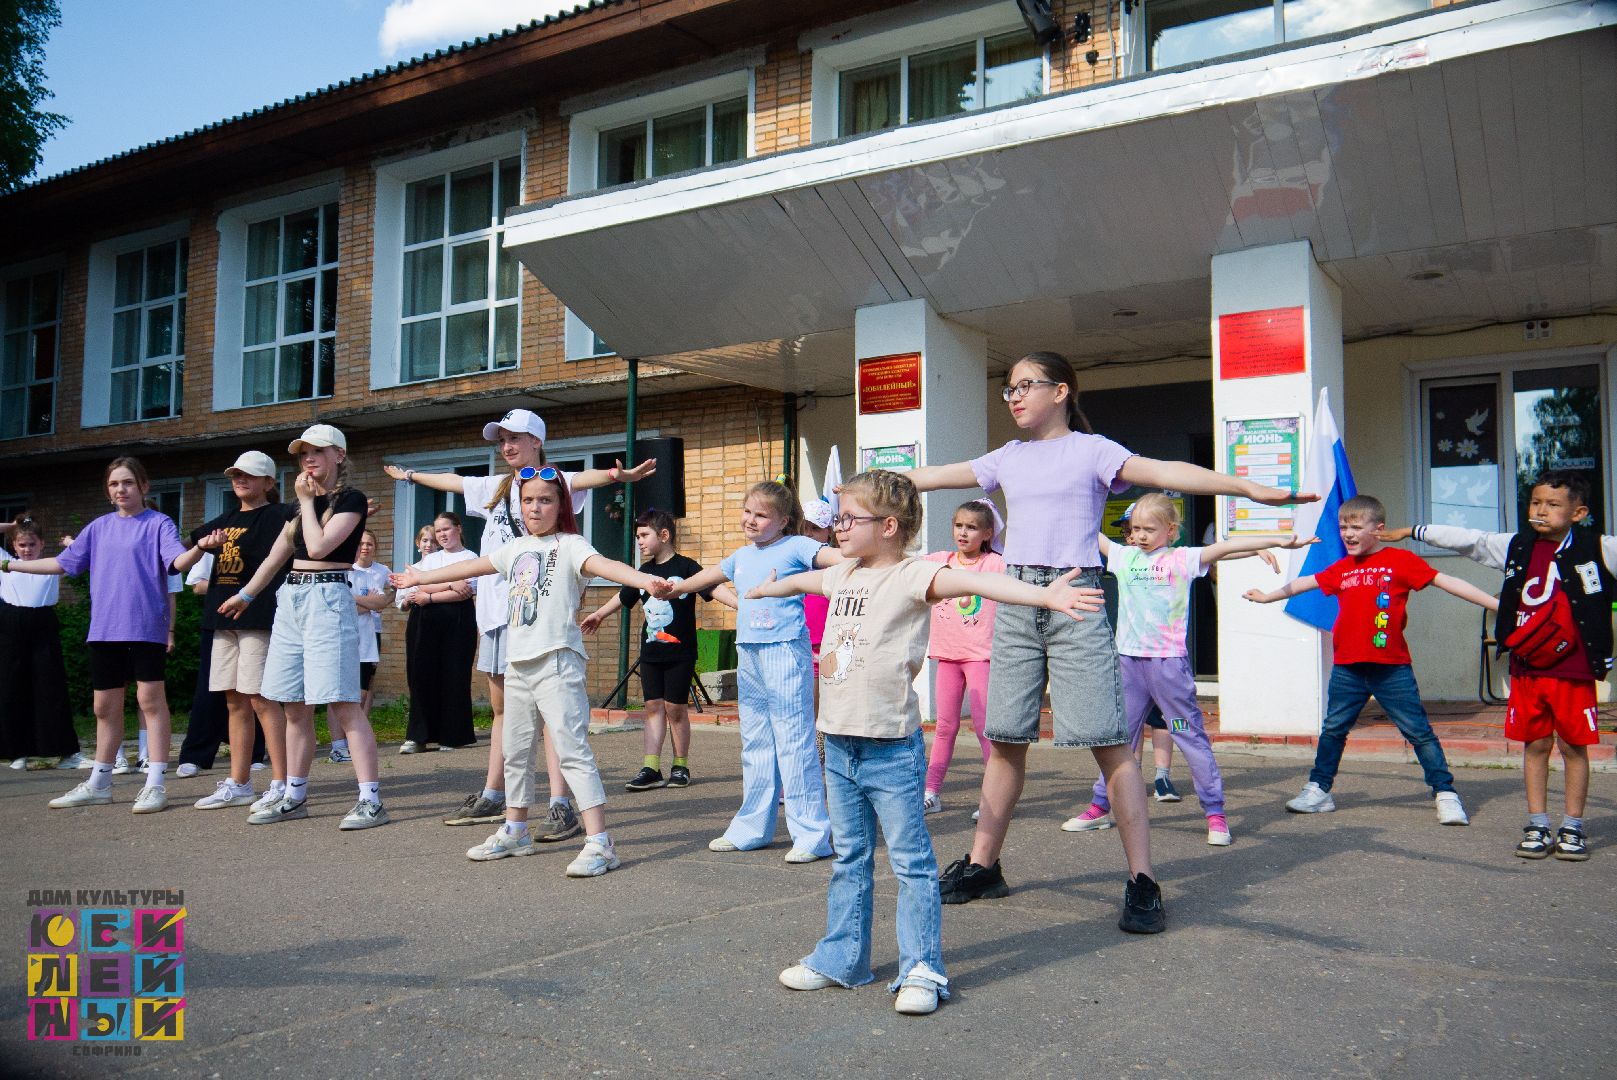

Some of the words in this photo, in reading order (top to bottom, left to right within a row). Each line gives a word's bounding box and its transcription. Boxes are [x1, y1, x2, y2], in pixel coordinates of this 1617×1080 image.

[862, 380, 917, 393] «ЮБИЛЕЙНЫЙ»
[1243, 433, 1284, 444] ИЮНЬ
[875, 455, 905, 465] ИЮНЬ
[1363, 574, 1374, 586] US
[831, 596, 869, 617] UTIE
